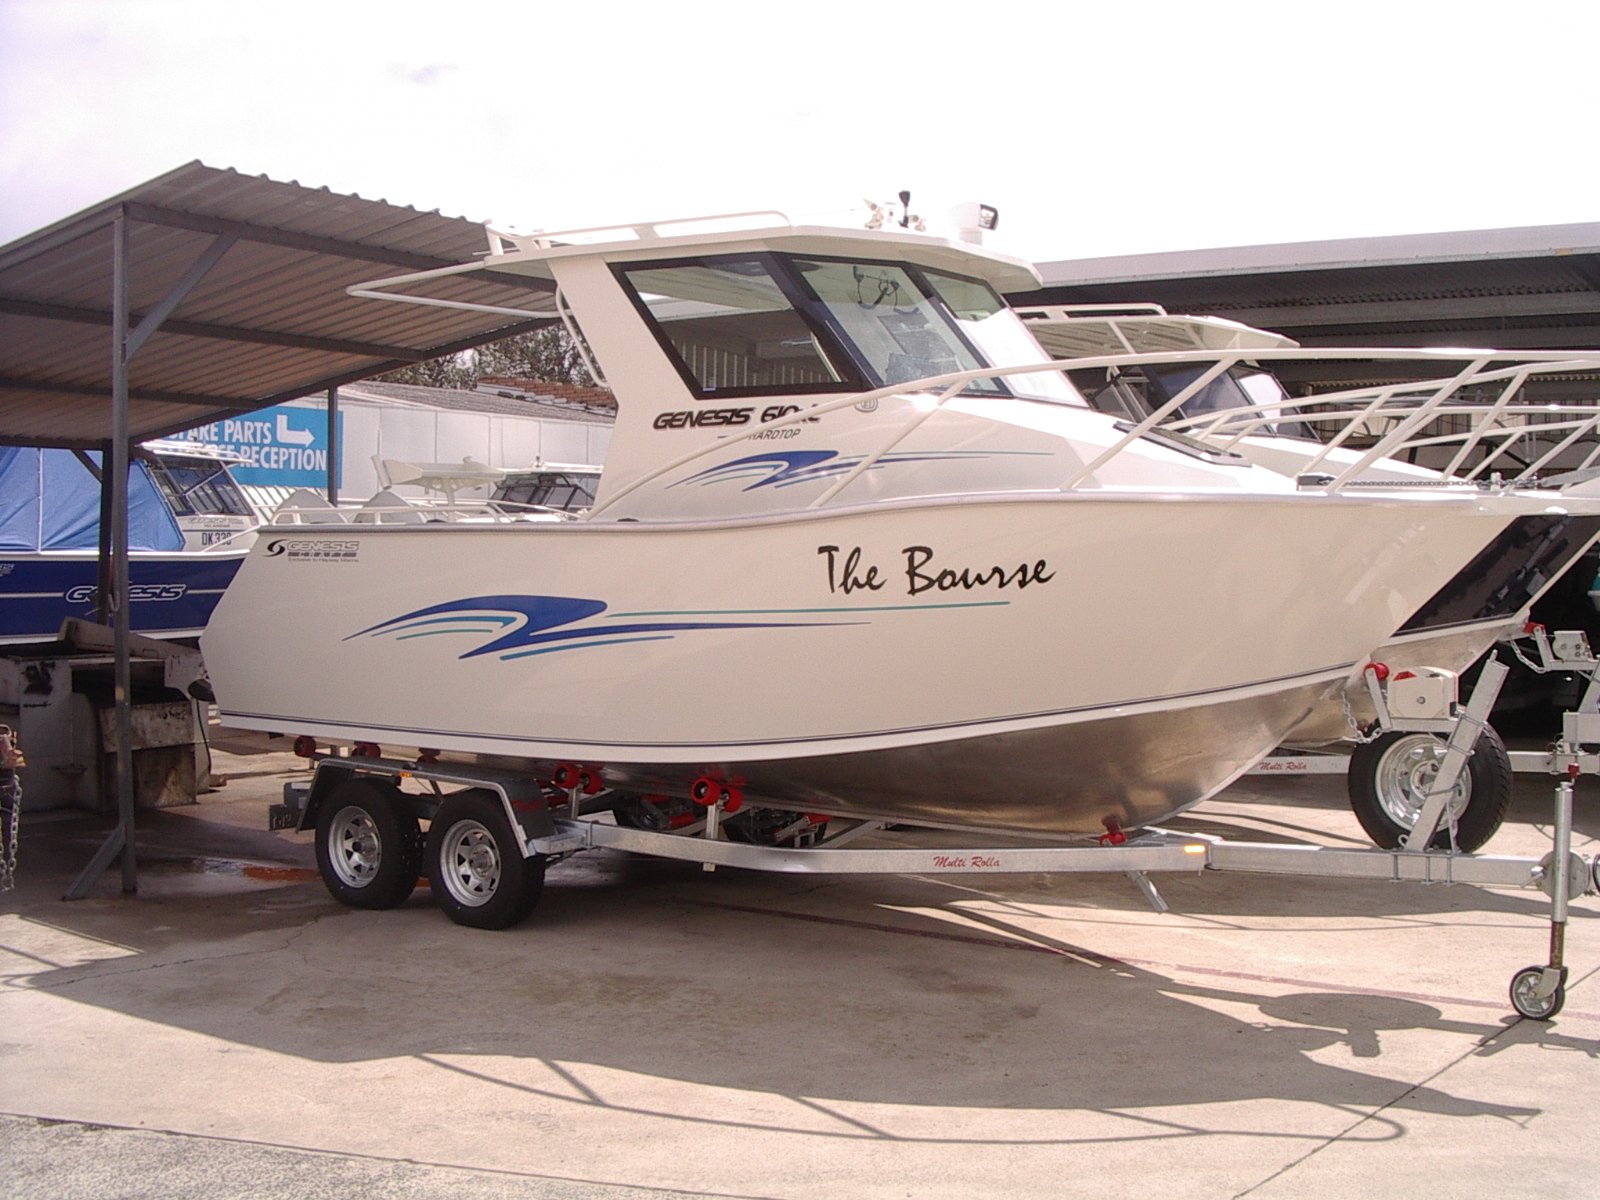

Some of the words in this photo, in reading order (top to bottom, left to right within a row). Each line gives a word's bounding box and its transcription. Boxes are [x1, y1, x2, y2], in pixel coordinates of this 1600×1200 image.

[653, 407, 755, 429] GENESIS
[224, 419, 272, 444] PARTS
[240, 444, 327, 471] RECEPTION
[287, 540, 359, 551] GENESIS
[817, 545, 888, 595] The
[901, 545, 1057, 596] Bourse
[933, 855, 966, 868] Multi
[971, 855, 1001, 868] Rolla
